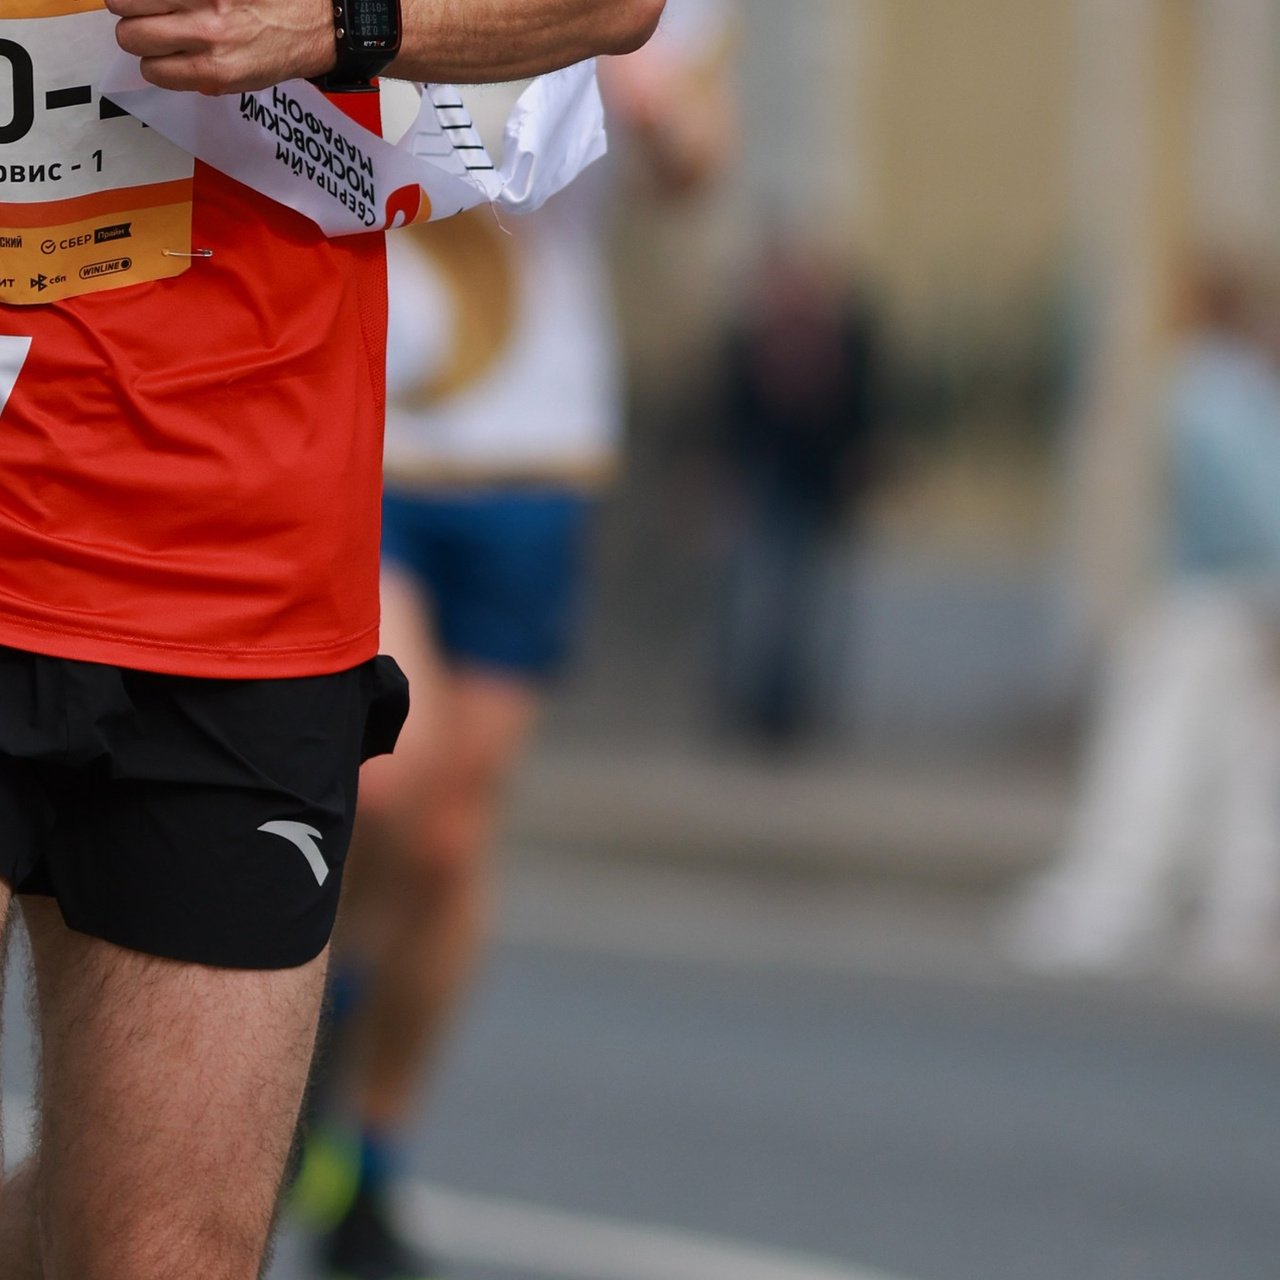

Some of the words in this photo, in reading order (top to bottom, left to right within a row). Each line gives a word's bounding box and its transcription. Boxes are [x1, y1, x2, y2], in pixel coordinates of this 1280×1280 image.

[272, 86, 374, 178] МАРАФОН
[92, 148, 103, 173] 1
[239, 91, 376, 207] МОСКОВСКИЙ
[276, 141, 377, 227] СБЕРПРАЙМ
[59, 233, 92, 250] СБЕР
[49, 275, 66, 285] сбп
[83, 261, 120, 277] WINLINE
